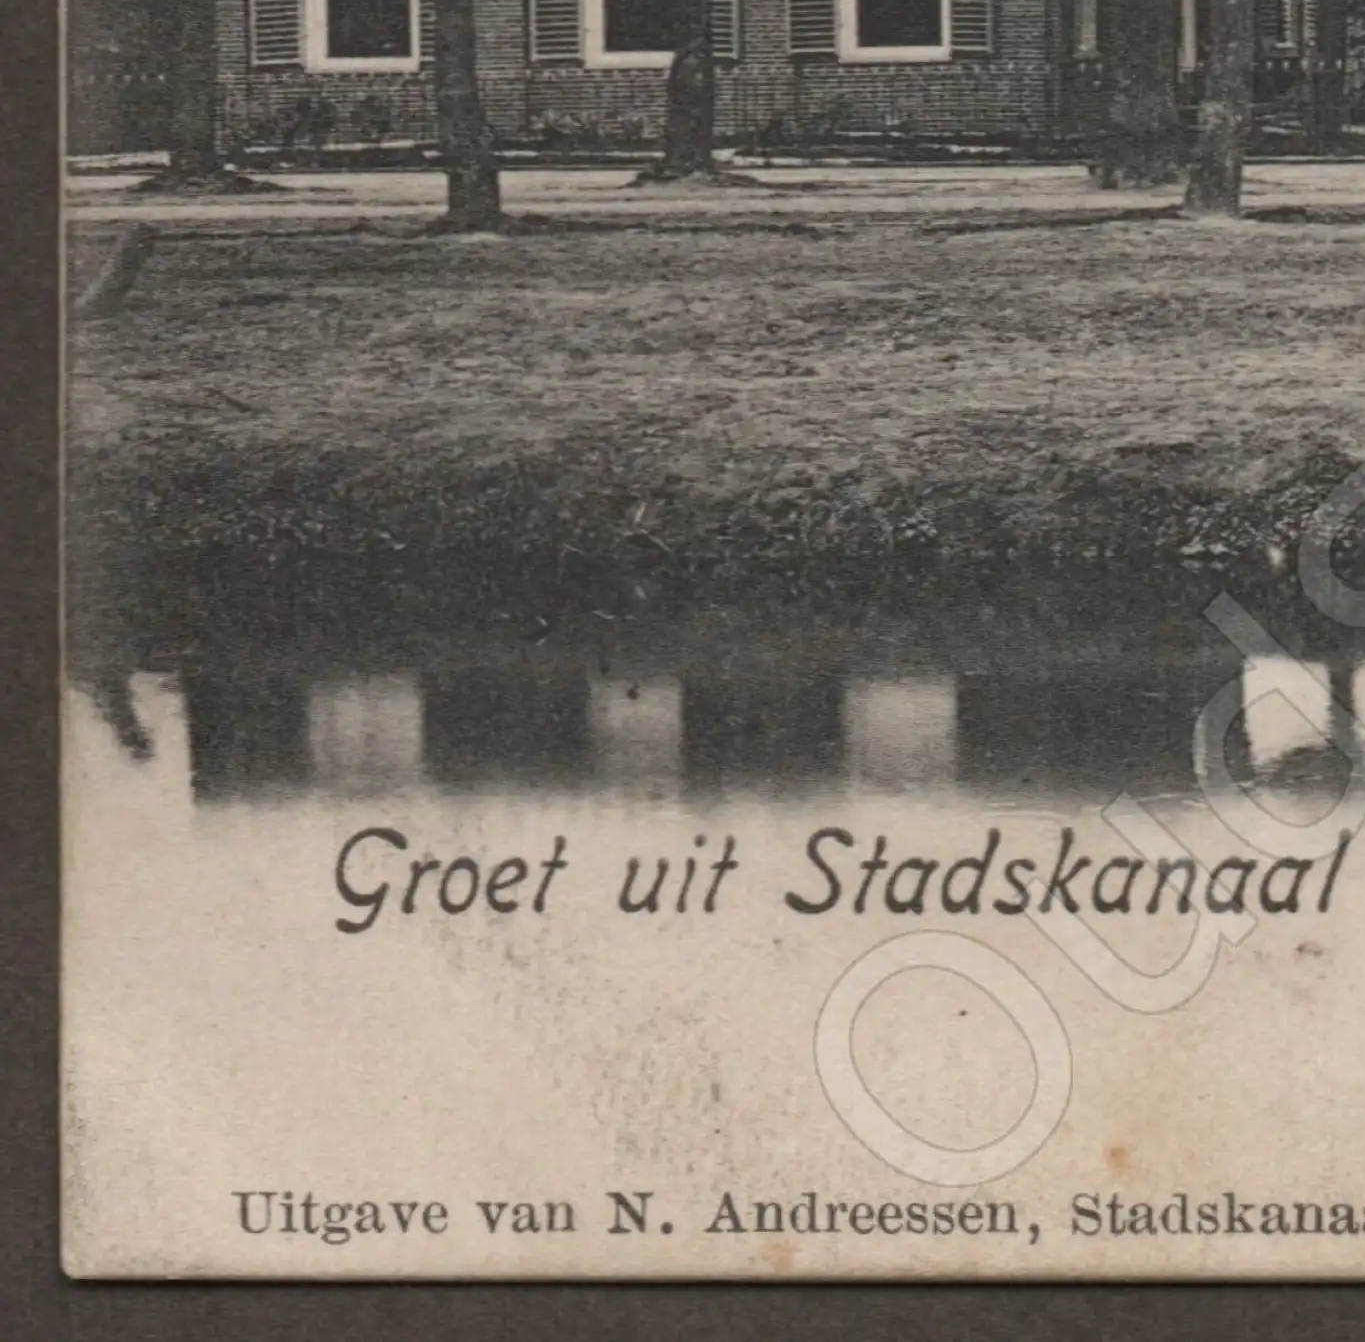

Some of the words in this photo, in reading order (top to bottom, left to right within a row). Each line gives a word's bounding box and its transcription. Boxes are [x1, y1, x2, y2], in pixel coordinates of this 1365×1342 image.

[335, 826, 567, 934] Groet
[618, 834, 738, 914] uit
[783, 826, 1352, 916] Stadskanaal
[234, 1190, 449, 1246] Uitgave
[475, 1200, 577, 1235] van
[606, 1190, 674, 1236] N.
[703, 1190, 1041, 1246] Andreessen,
